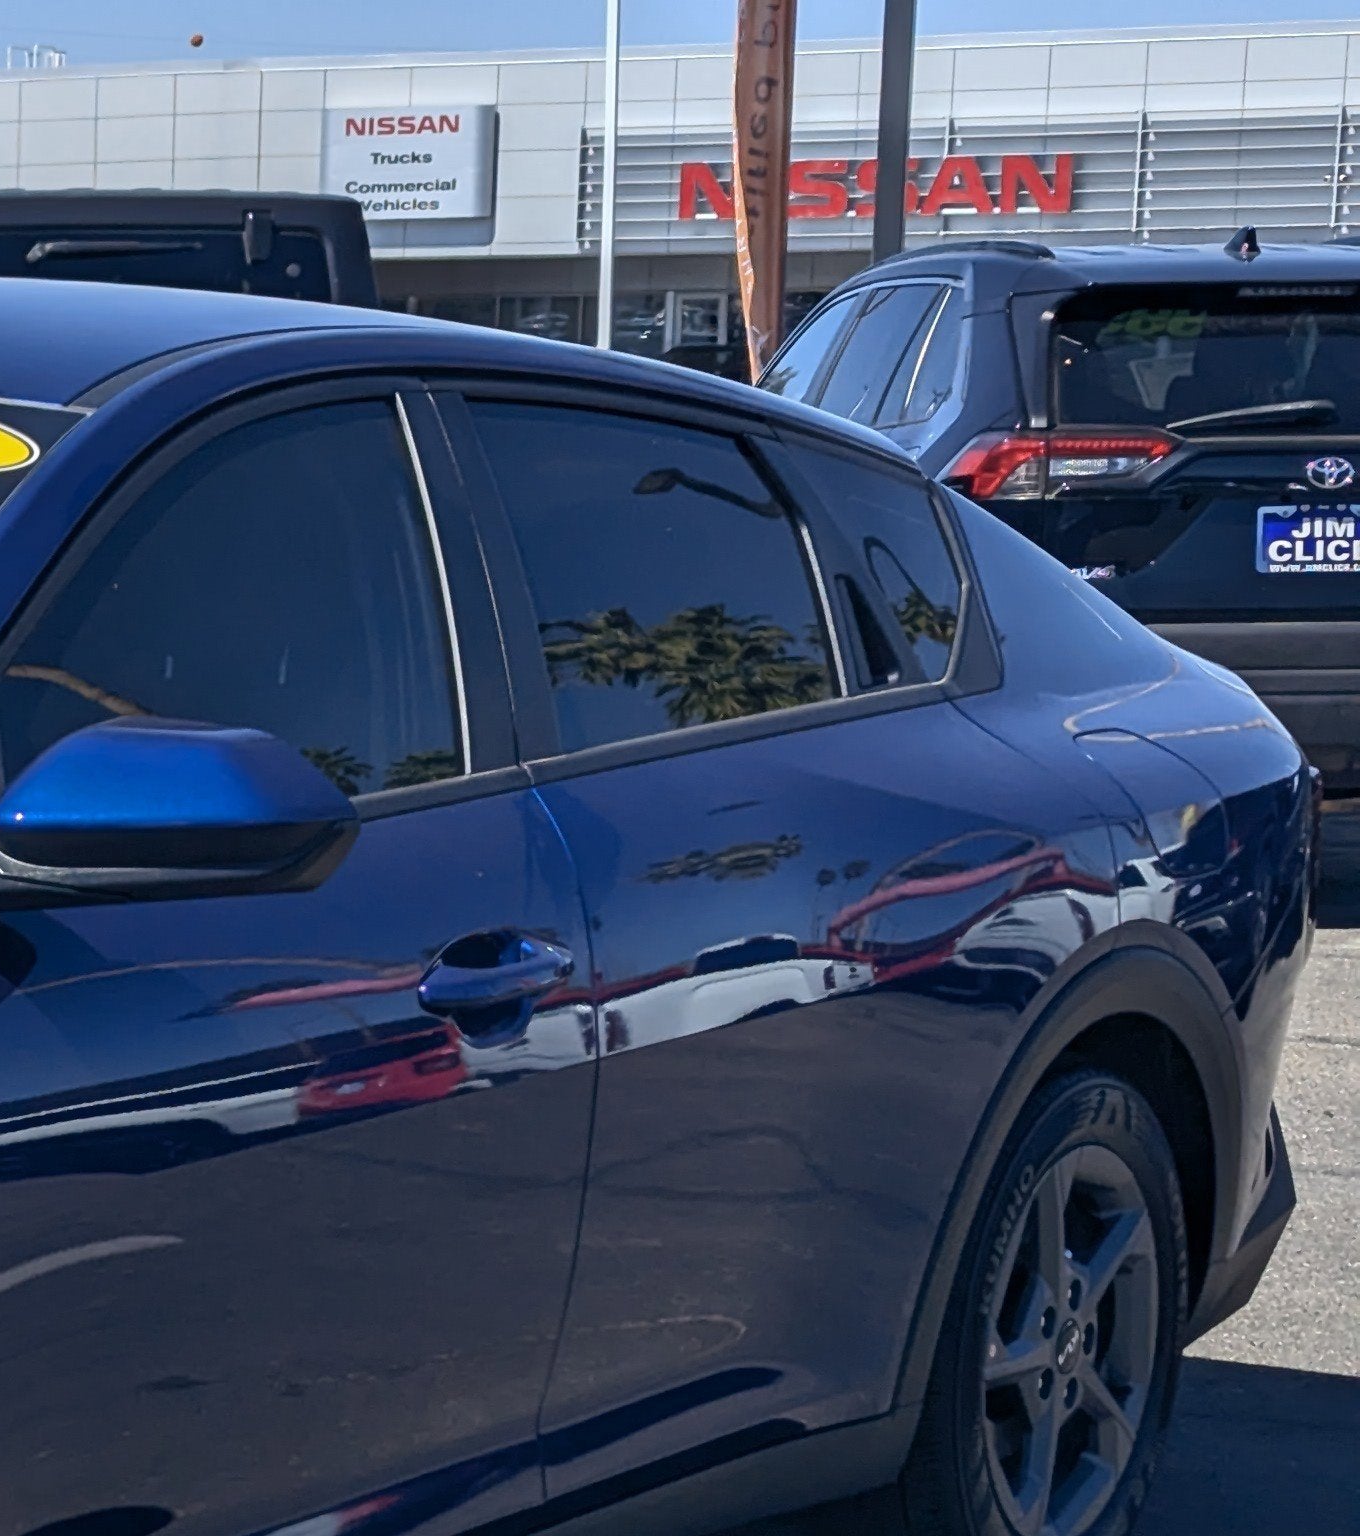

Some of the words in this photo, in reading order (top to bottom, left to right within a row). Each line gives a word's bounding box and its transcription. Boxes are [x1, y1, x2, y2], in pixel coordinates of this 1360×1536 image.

[345, 114, 460, 137] NISSAN
[370, 151, 433, 165] Trucks
[344, 178, 457, 194] Commercial
[678, 153, 1073, 221] NSSAN
[360, 198, 440, 212] Vehicles
[1291, 517, 1355, 538] JIM
